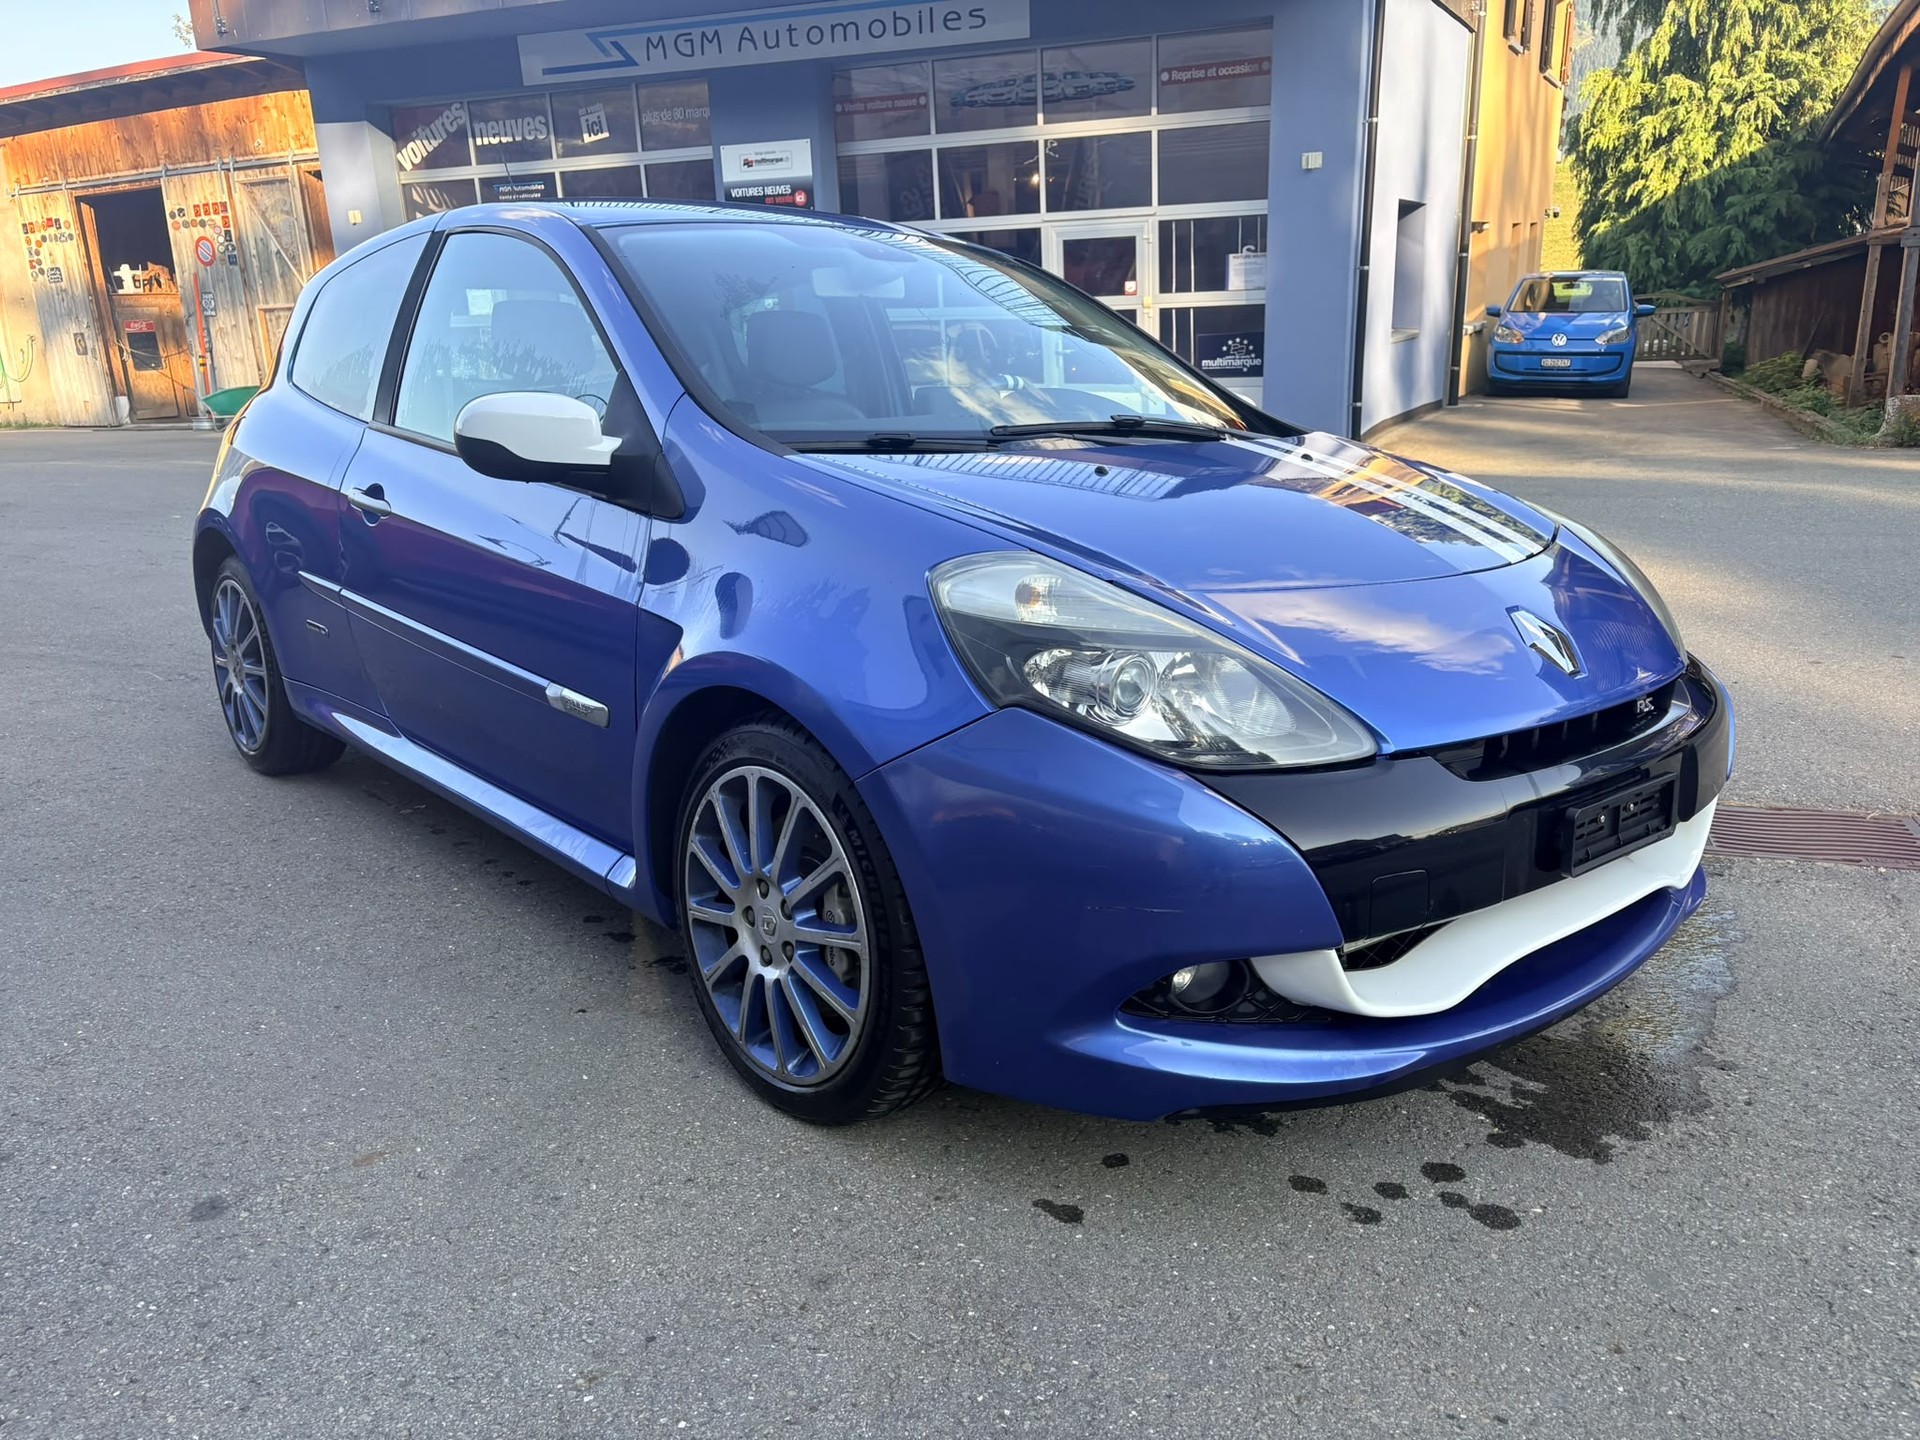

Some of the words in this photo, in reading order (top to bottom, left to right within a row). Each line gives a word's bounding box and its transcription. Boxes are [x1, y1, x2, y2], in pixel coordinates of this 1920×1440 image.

[646, 29, 722, 62] MGM
[738, 7, 986, 52] Automobiles
[1171, 68, 1205, 81] Reprise
[1207, 67, 1217, 77] et
[1218, 63, 1259, 76] occasion
[585, 115, 604, 138] ici
[642, 110, 660, 126] plus
[661, 108, 672, 121] de
[396, 102, 466, 172] voitures
[474, 115, 548, 146] neuves
[730, 186, 764, 198] VOITURES
[764, 185, 791, 196] NEUVES
[1201, 357, 1262, 368] multimarque
